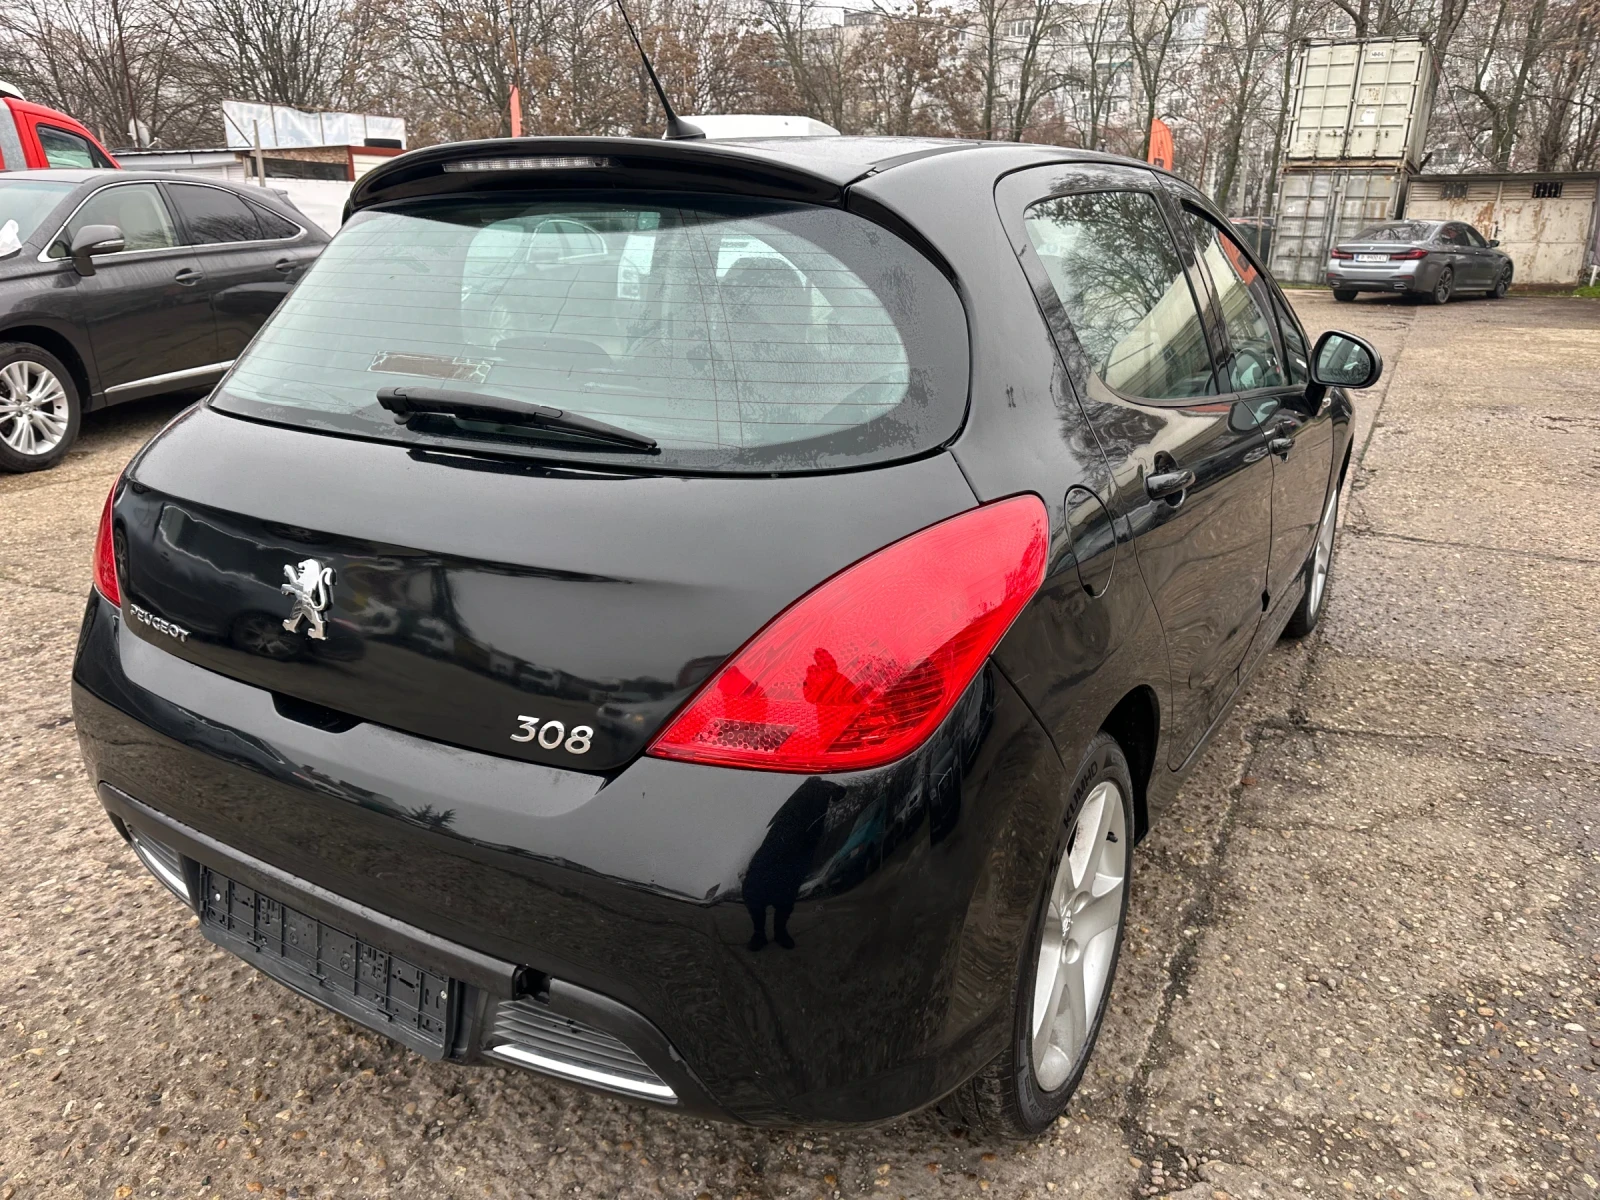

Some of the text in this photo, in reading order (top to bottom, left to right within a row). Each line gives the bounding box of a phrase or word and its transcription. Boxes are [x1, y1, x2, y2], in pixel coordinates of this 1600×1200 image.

[130, 603, 192, 643] PEUGEOT
[509, 714, 594, 755] 308
[1063, 760, 1099, 829] KUMHO
